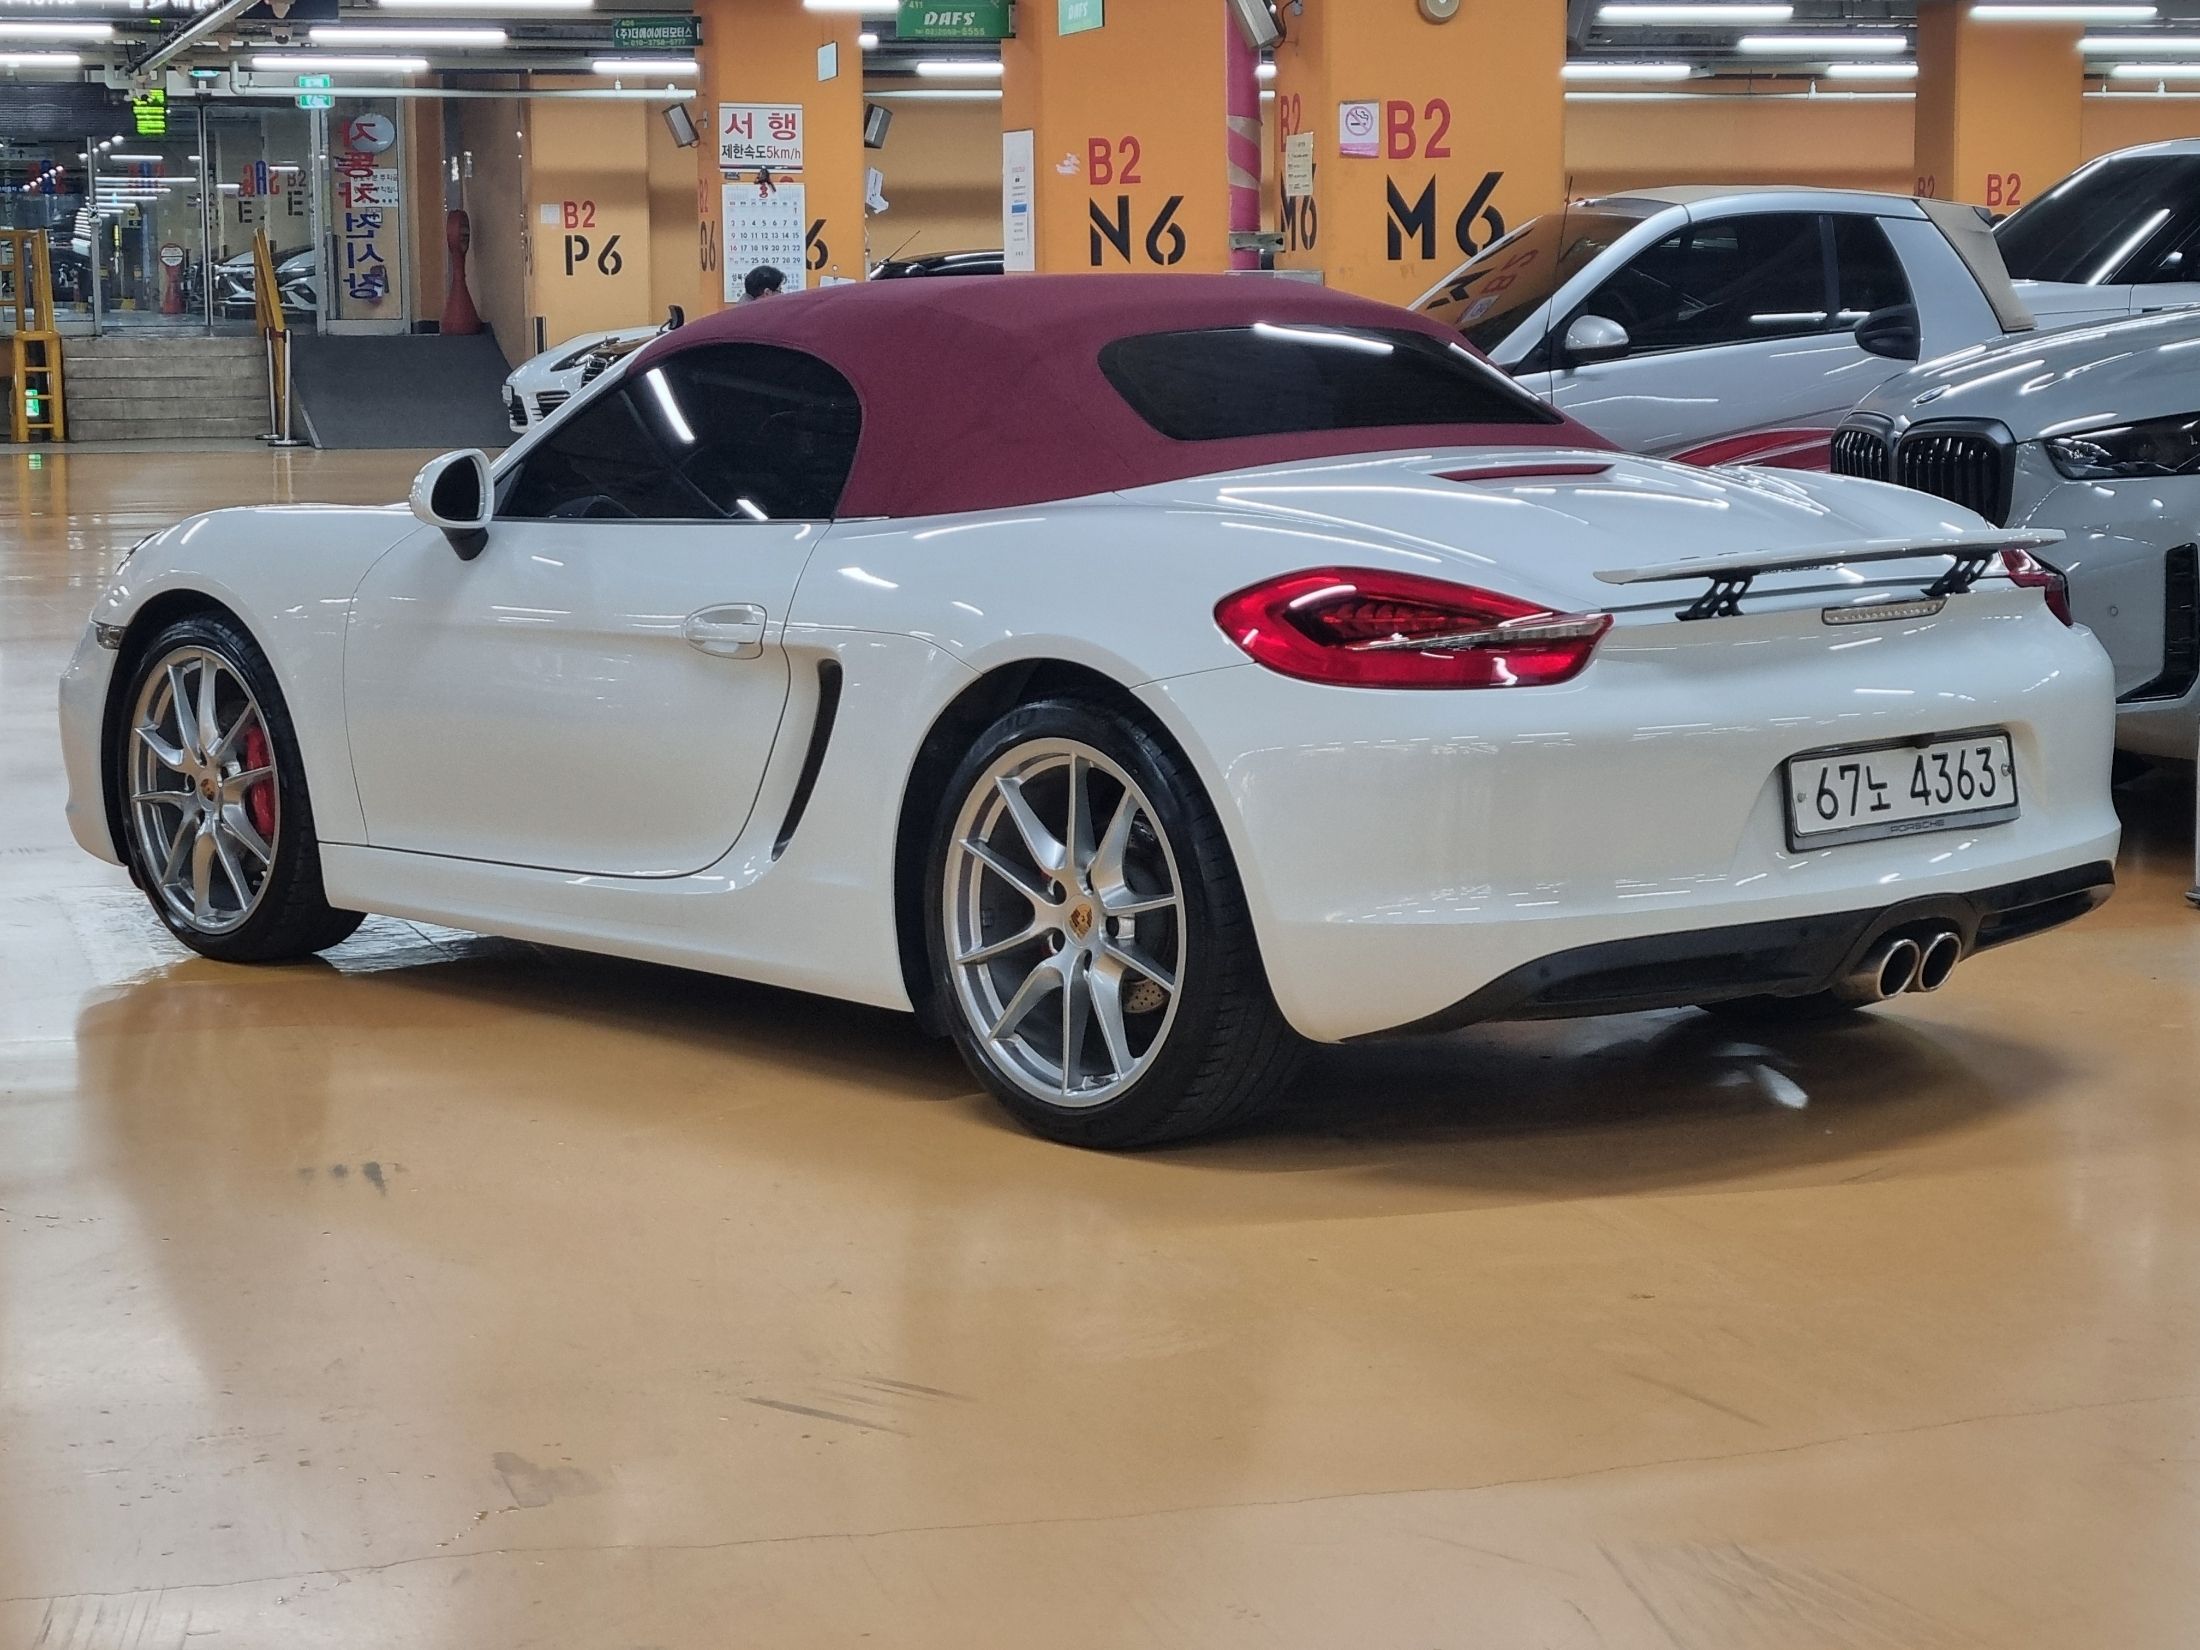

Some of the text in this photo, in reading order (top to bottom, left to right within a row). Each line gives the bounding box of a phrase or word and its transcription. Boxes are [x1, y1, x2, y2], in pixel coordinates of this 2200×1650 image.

[923, 11, 975, 26] DAFS
[1387, 98, 1451, 159] B2
[1089, 136, 1141, 185] B2
[1987, 173, 2021, 206] B2
[563, 201, 596, 229] B2
[1089, 195, 1186, 266] N6
[1387, 171, 1505, 260] M6
[565, 235, 622, 276] P6
[1816, 746, 1996, 820] 67노 4363
[1890, 819, 1945, 832] PORSCHE
